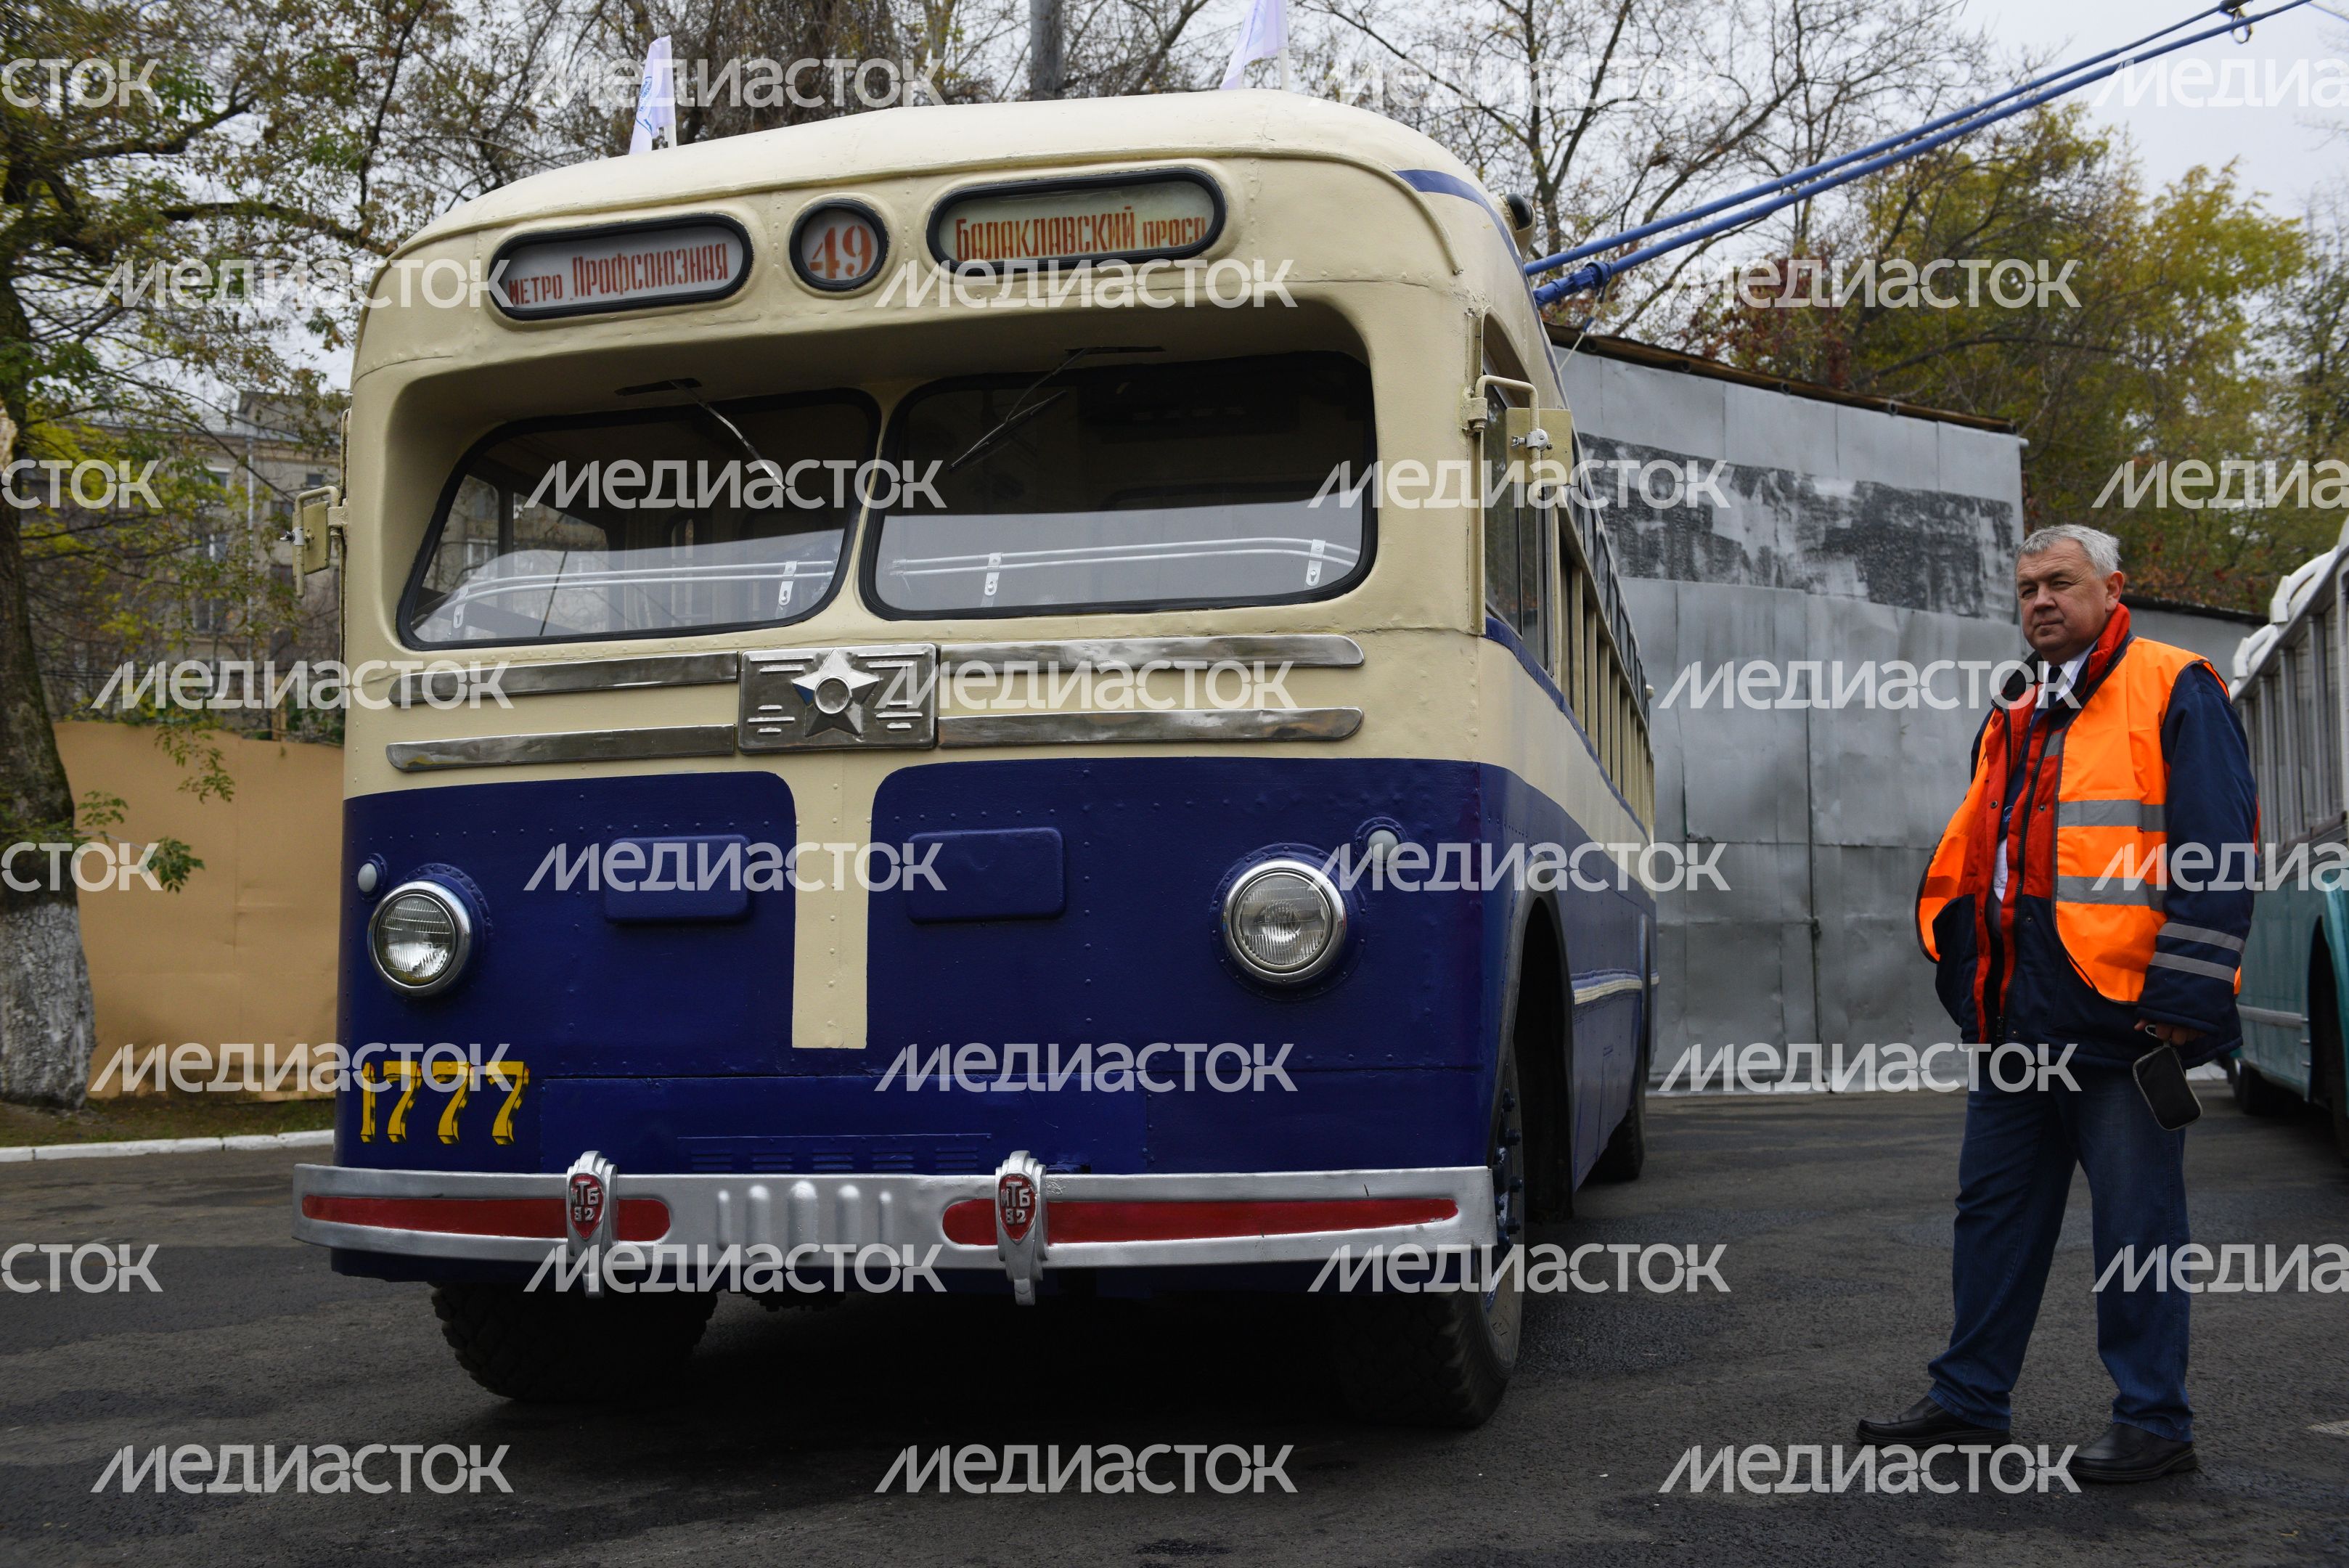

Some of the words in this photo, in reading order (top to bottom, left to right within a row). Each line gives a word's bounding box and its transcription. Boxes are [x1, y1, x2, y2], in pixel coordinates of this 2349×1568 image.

[809, 224, 873, 279] 49
[360, 1060, 530, 1146] 1777
[573, 1206, 596, 1222] 82
[1005, 1208, 1027, 1225] 82
